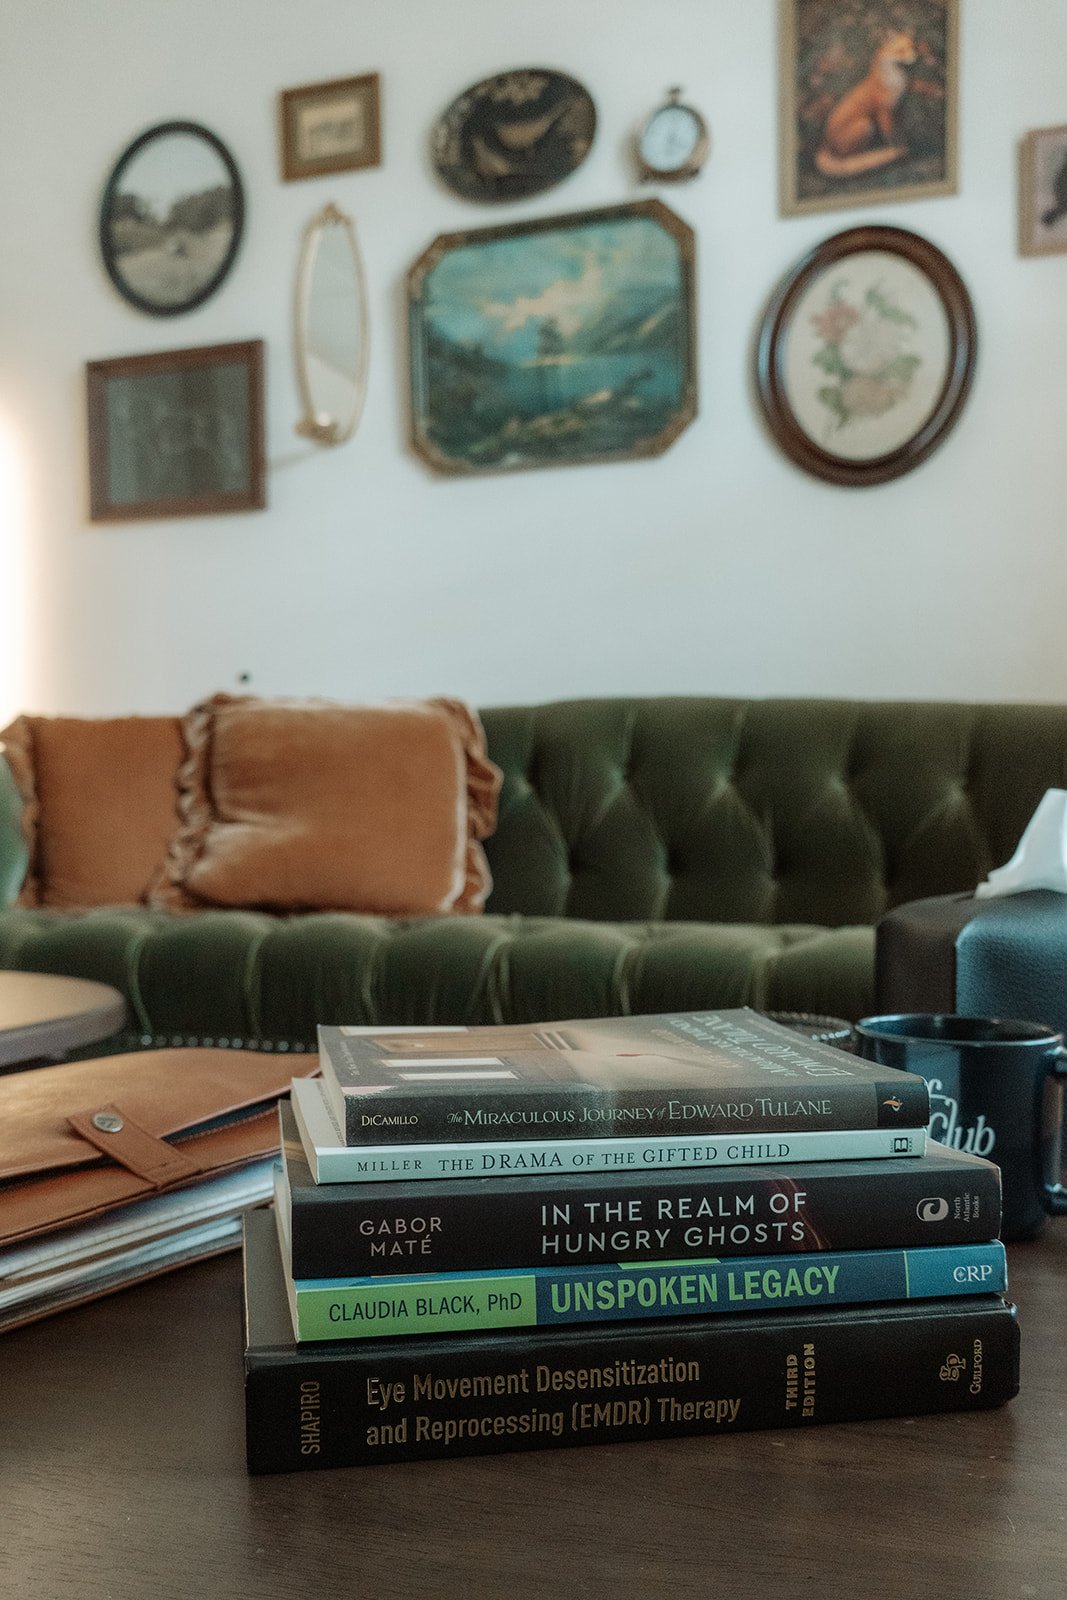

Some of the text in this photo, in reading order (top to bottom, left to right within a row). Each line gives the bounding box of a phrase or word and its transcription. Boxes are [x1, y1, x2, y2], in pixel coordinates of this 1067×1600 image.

[464, 1107, 576, 1126] MIRACULOUS
[578, 1104, 658, 1122] JOURNEY
[668, 1101, 753, 1121] EDWARD
[755, 1098, 833, 1116] TULANE
[357, 1143, 791, 1172] MILLER THE DRAMA OF THE GIFTED CHILD
[359, 1216, 443, 1236] GABOR
[541, 1192, 808, 1226] IN THE REALM OF
[370, 1234, 432, 1257] MATÉ
[541, 1221, 806, 1255] HUNGRY GHOSTS
[550, 1264, 841, 1314] UNSPOKEN LEGACY
[953, 1264, 993, 1283] CRP
[328, 1292, 523, 1323] CLAUDIA BLACK, PhD
[785, 1353, 799, 1411] THIRD
[802, 1343, 816, 1417] EDITION
[969, 1338, 983, 1395] GUILFORD
[366, 1357, 701, 1411] Eye Movement Desensitization
[300, 1379, 321, 1456] SHAPIRO
[366, 1396, 742, 1446] and Reprocessing (EMDR) Therapy
